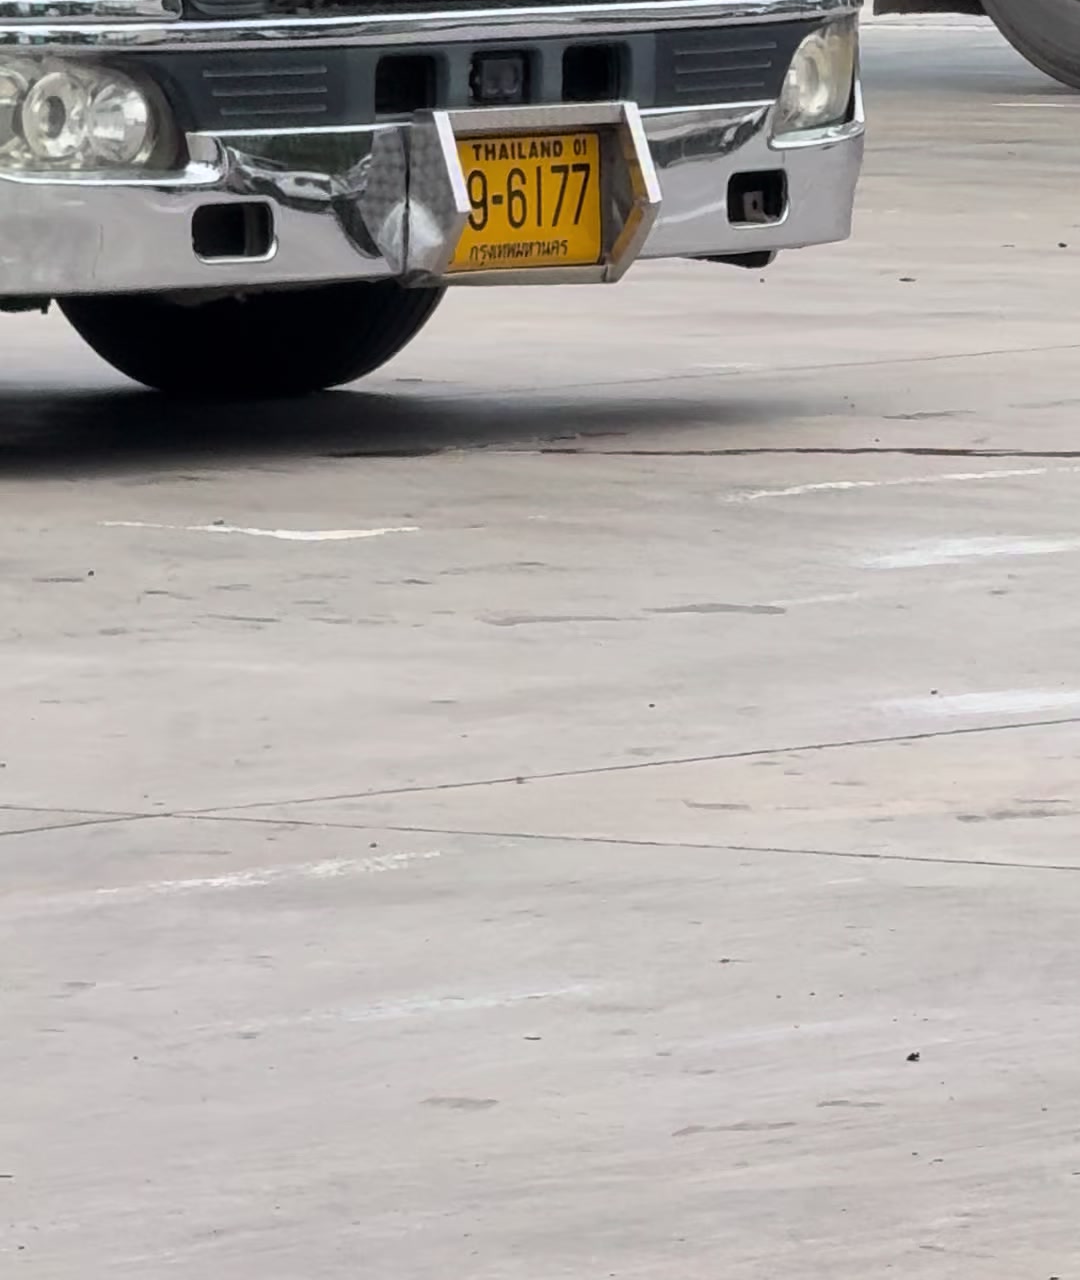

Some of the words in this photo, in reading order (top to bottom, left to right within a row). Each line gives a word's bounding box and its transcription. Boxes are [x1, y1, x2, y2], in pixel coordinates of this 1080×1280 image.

[472, 140, 563, 161] THAILAND
[469, 239, 568, 267] กรุงเทพมหานคร
